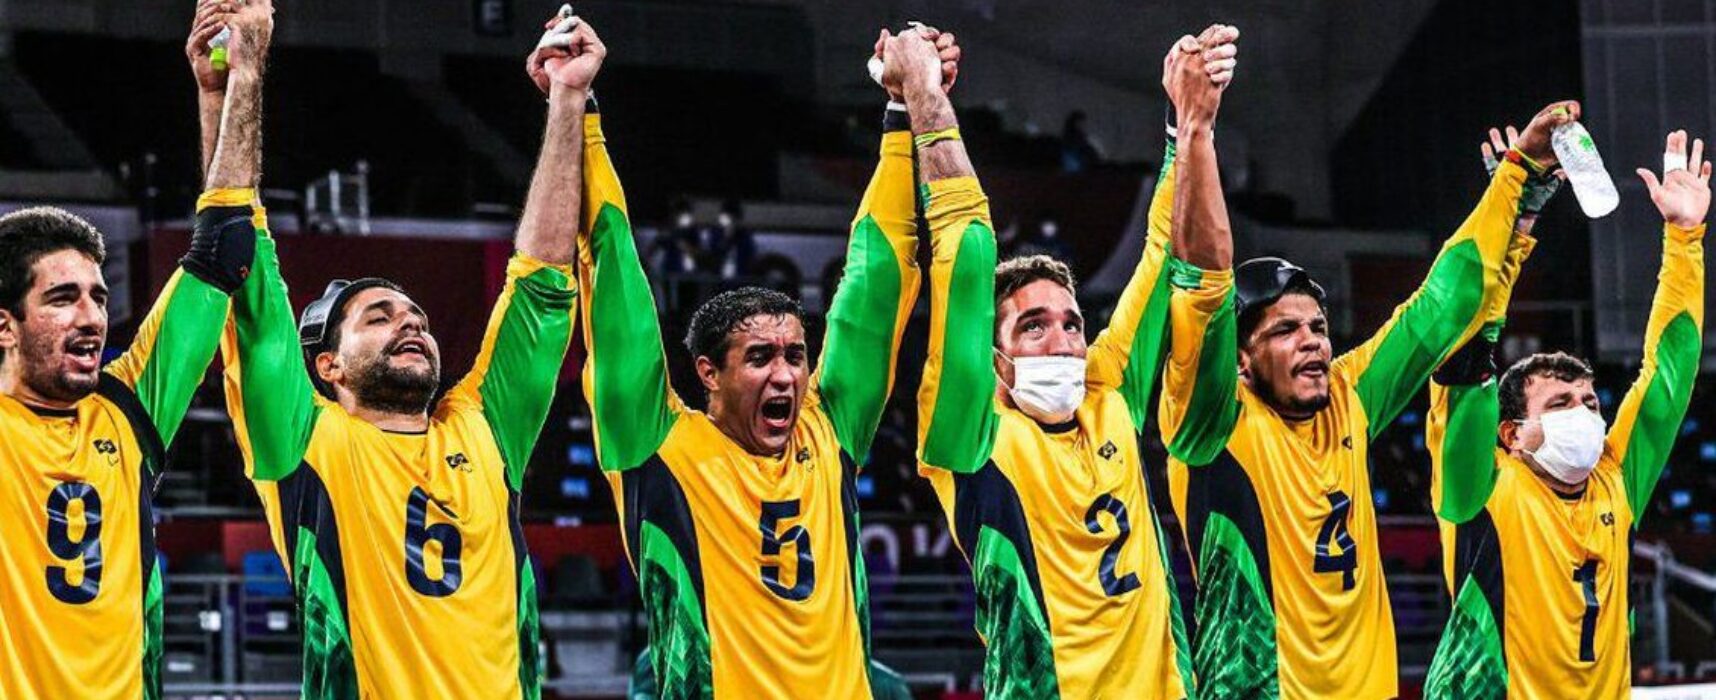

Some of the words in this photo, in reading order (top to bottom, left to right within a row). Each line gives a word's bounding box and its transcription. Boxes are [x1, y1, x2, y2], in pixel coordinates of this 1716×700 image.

[45, 479, 102, 604] 9
[405, 486, 462, 597] 6
[759, 499, 815, 601] 5
[1085, 493, 1141, 596] 2
[1313, 491, 1357, 591] 4
[1573, 558, 1600, 662] 1
